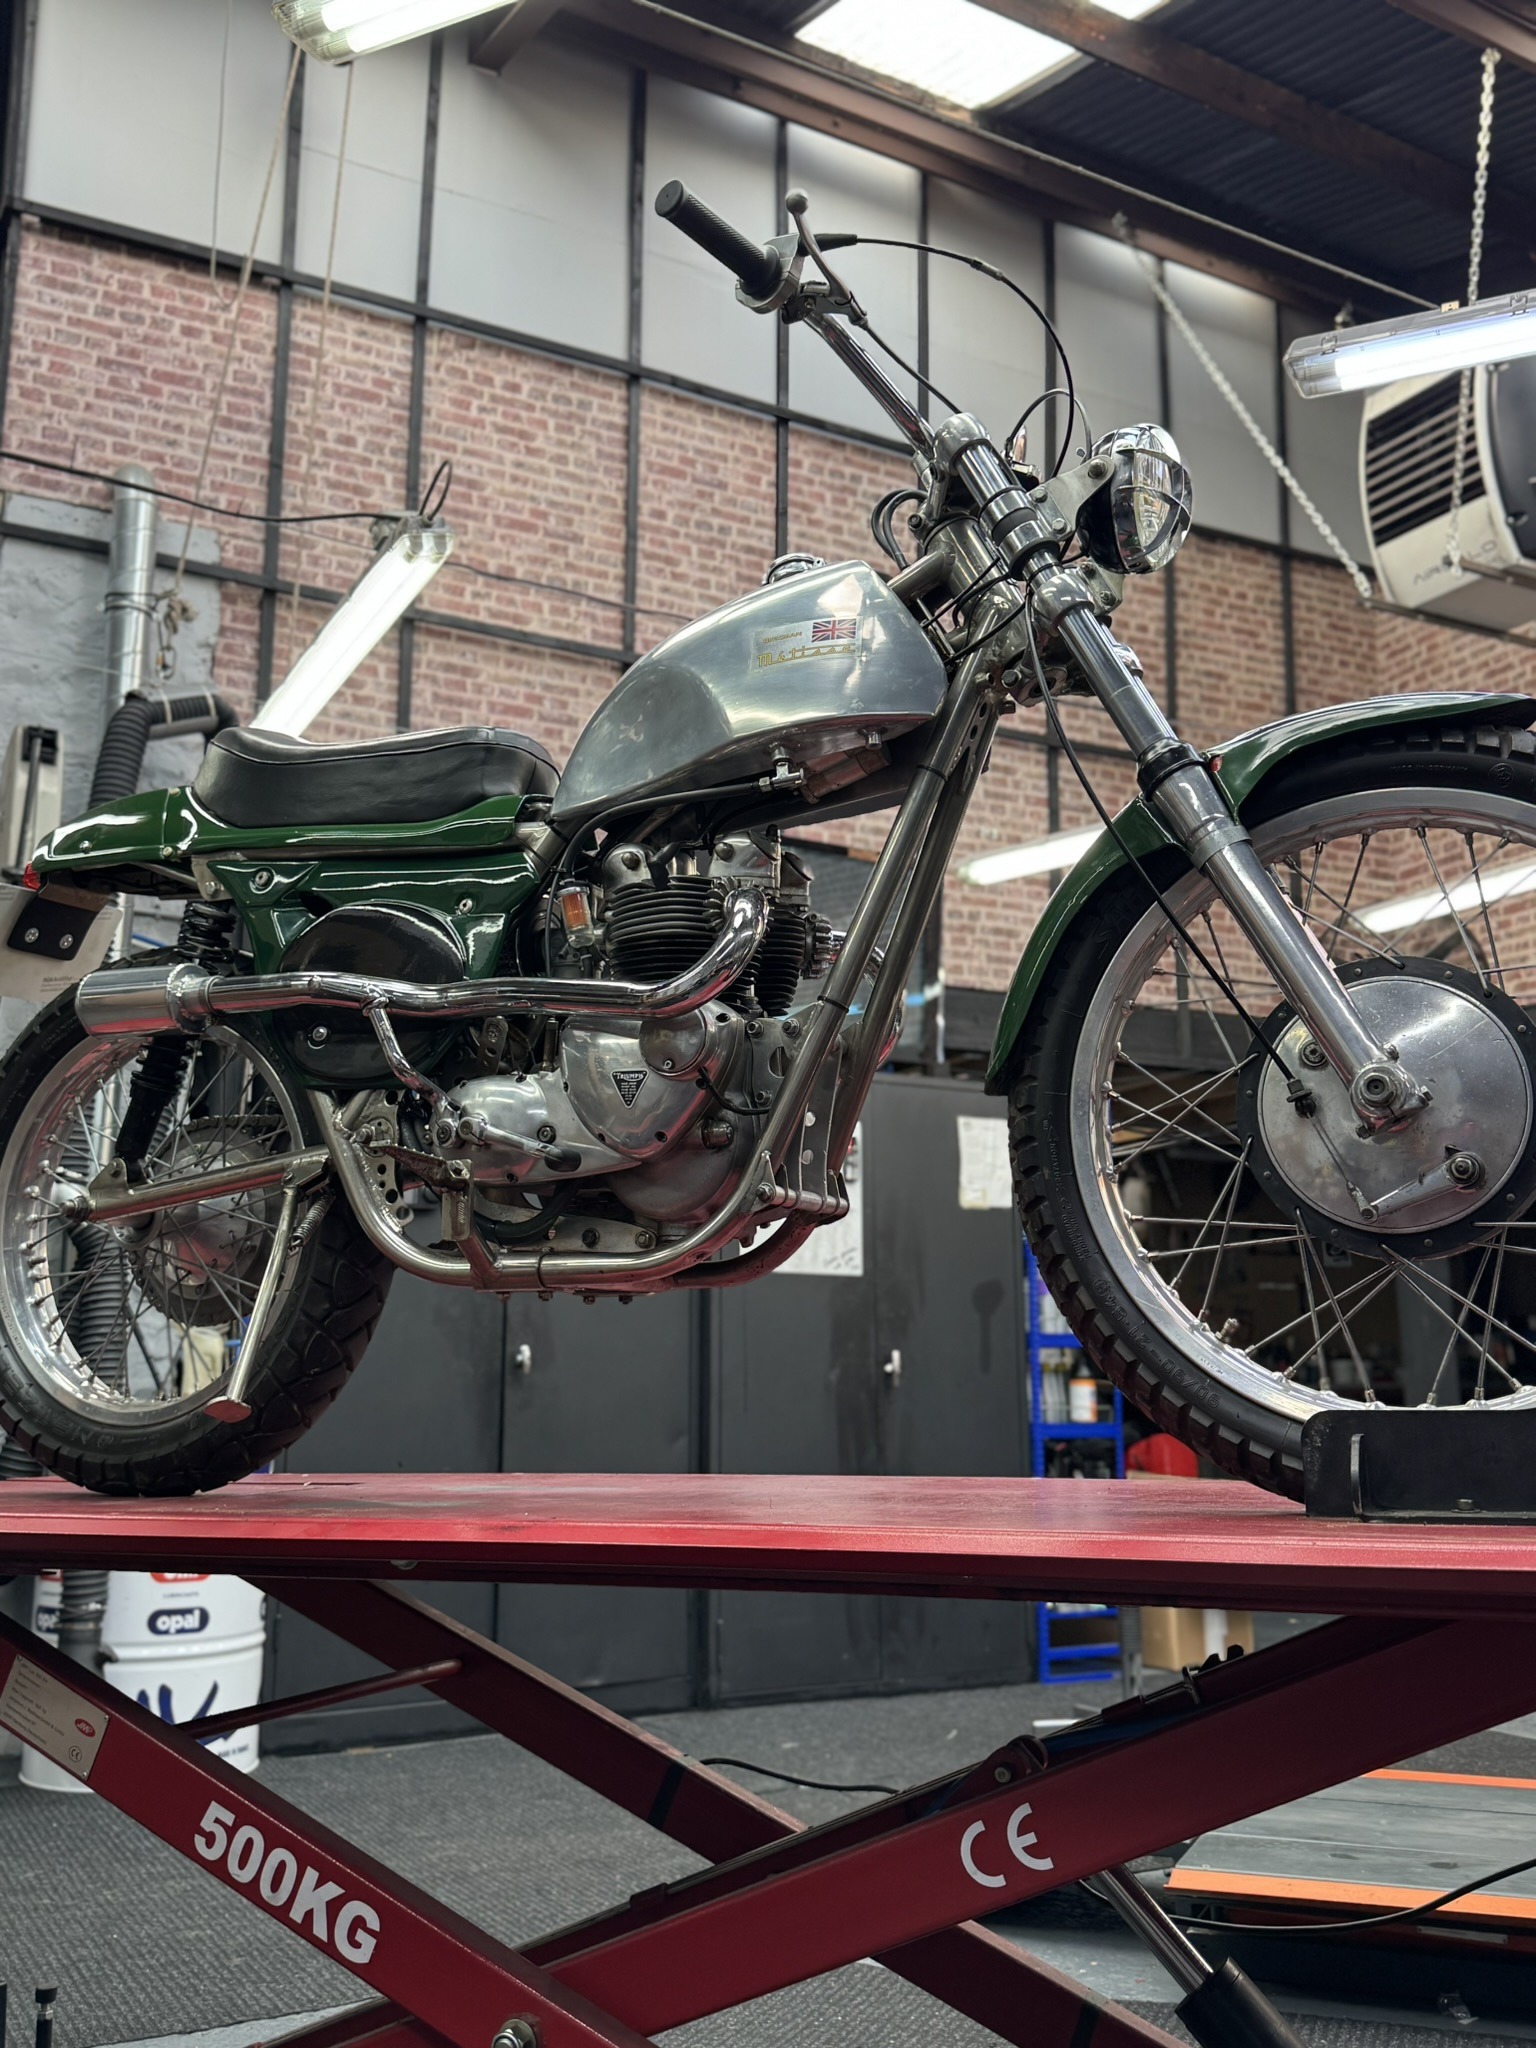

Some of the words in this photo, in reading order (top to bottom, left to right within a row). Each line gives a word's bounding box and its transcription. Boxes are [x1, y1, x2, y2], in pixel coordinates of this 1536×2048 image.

[613, 1072, 645, 1081] TRIUMPH
[155, 1610, 201, 1634] opal
[962, 1802, 1053, 1887] CE
[195, 1802, 381, 1964] 500KG
